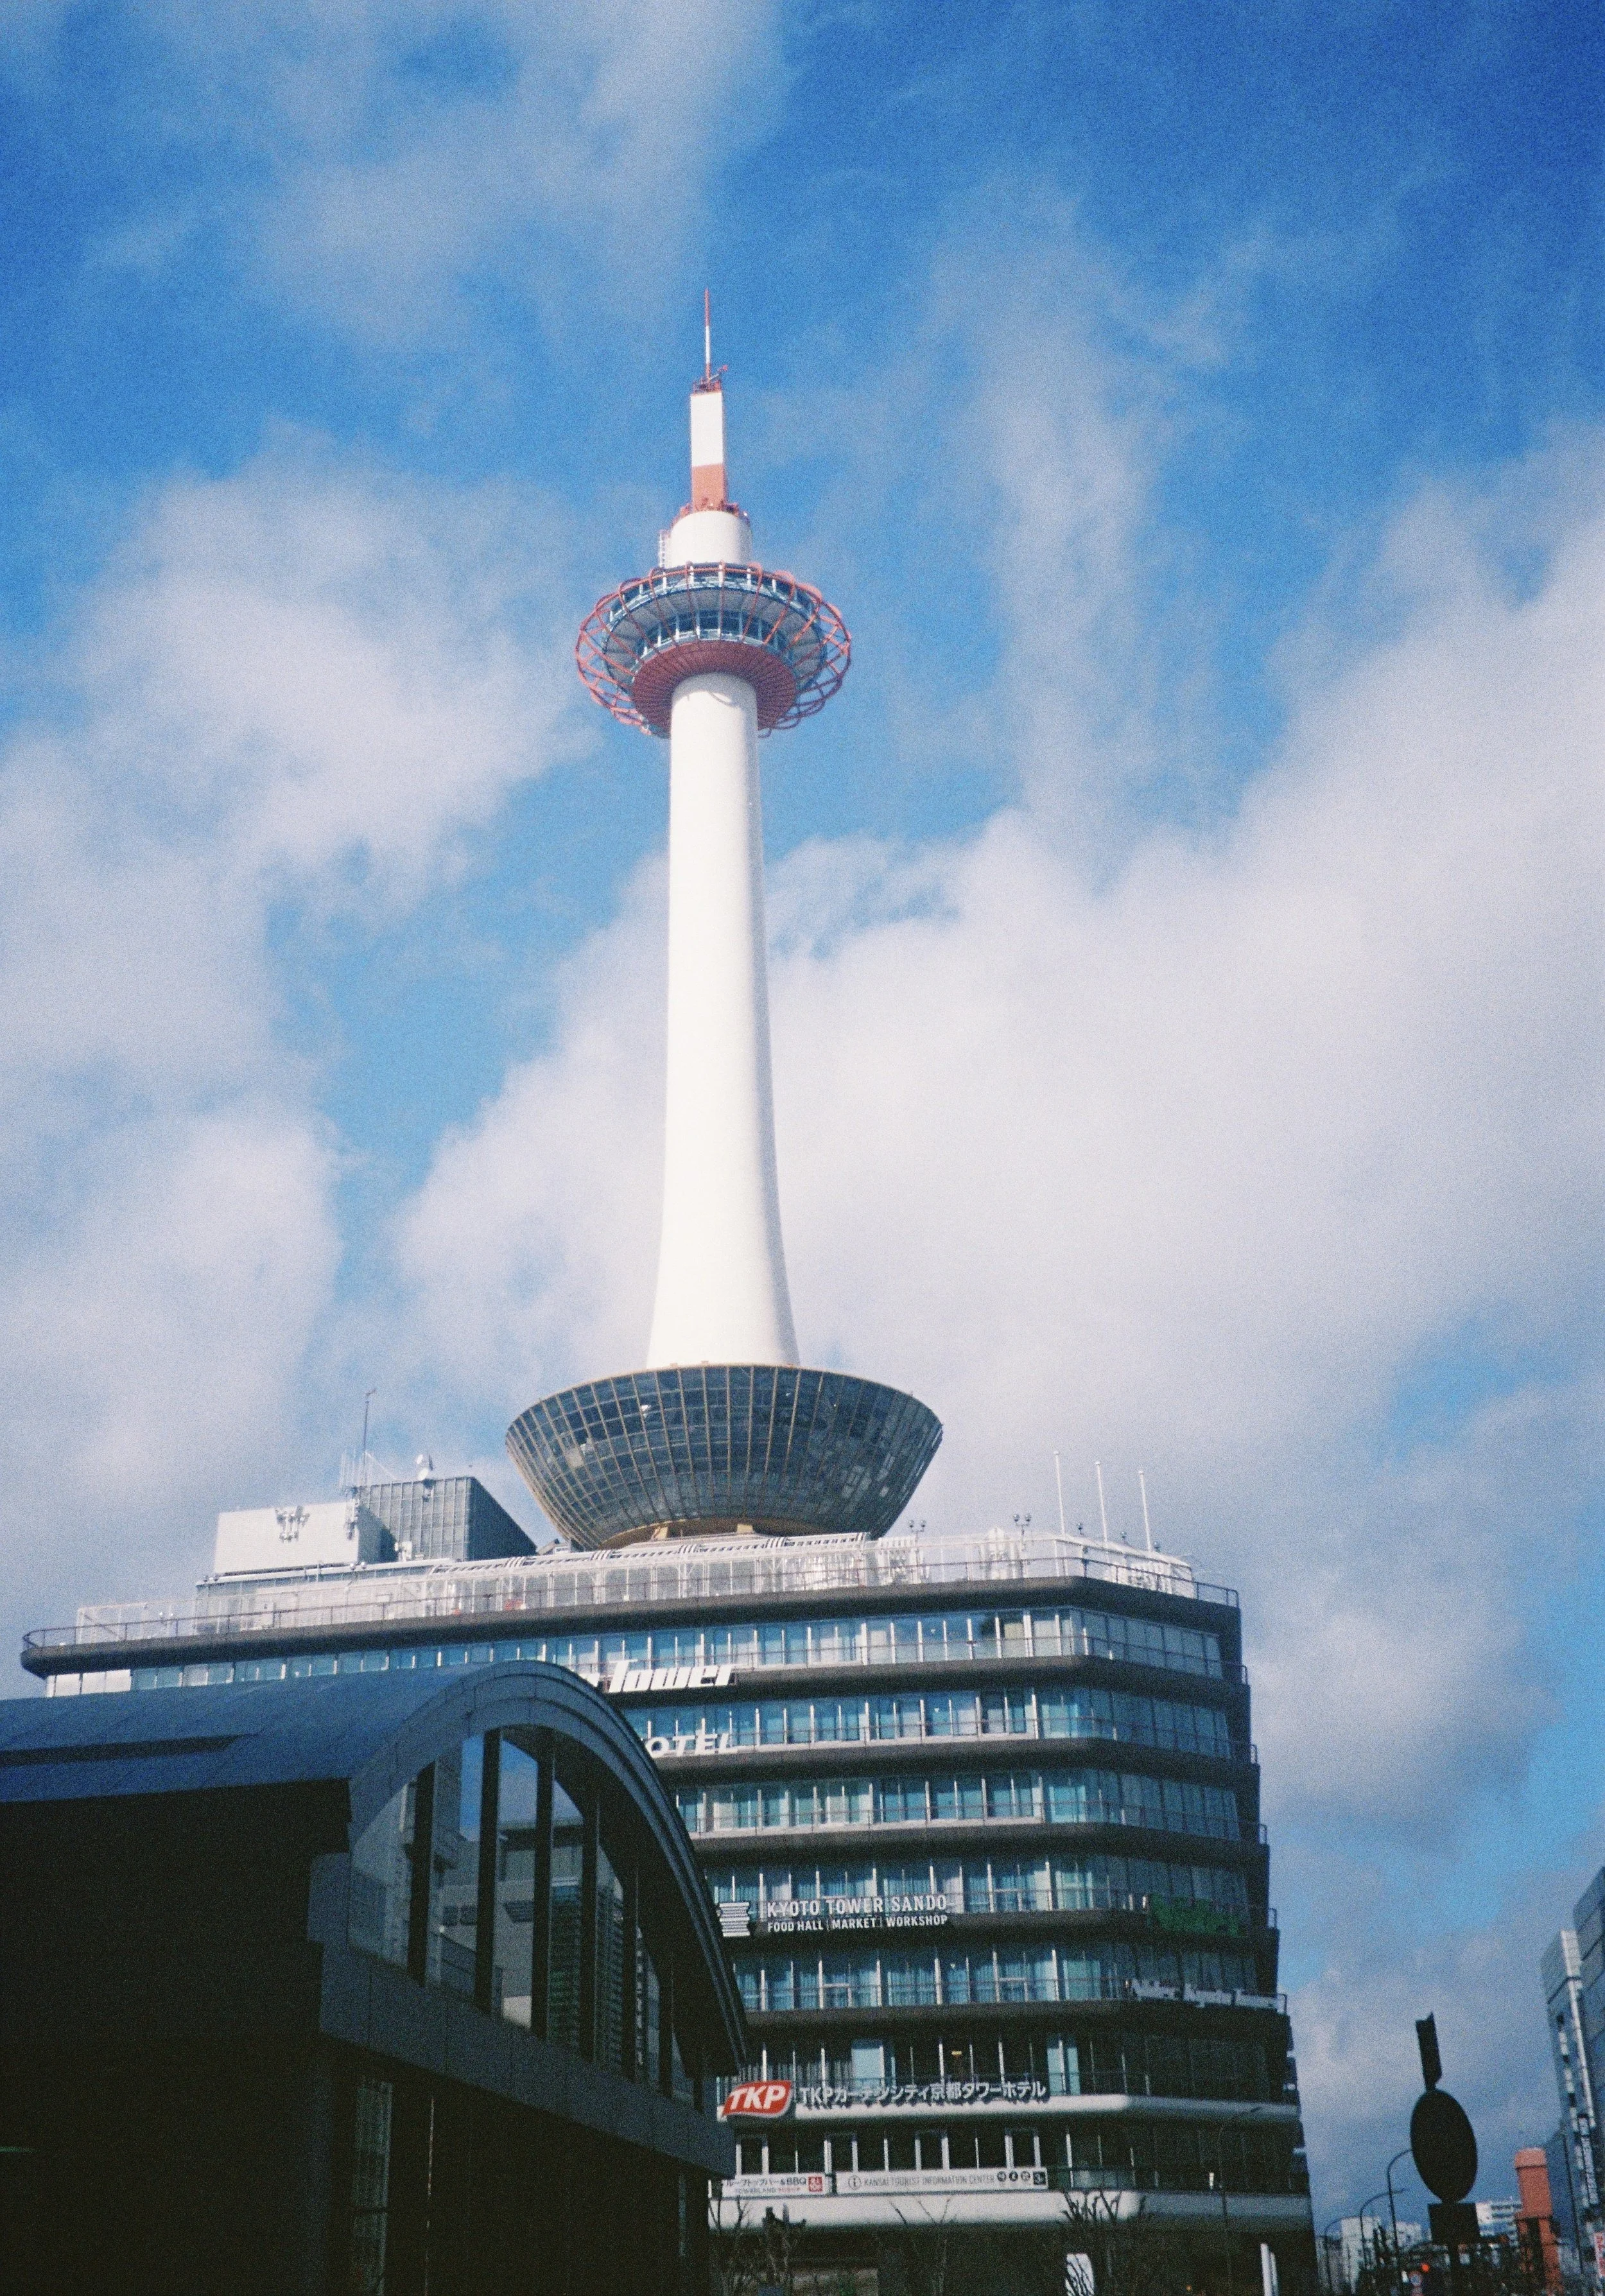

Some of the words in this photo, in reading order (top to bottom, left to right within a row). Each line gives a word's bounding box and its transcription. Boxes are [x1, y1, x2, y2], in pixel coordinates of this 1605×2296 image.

[608, 1659, 734, 1692] Tower
[641, 1733, 738, 1758] OTEL
[767, 1900, 819, 1917] KYOTO
[826, 1897, 883, 1915] TOWER
[892, 1894, 947, 1912] SANDO
[767, 1921, 794, 1932] FOOD
[797, 1919, 823, 1931] HALL
[833, 1917, 877, 1929] MARKET
[887, 1914, 948, 1927] WORKSHOP
[729, 2085, 786, 2110] TKP
